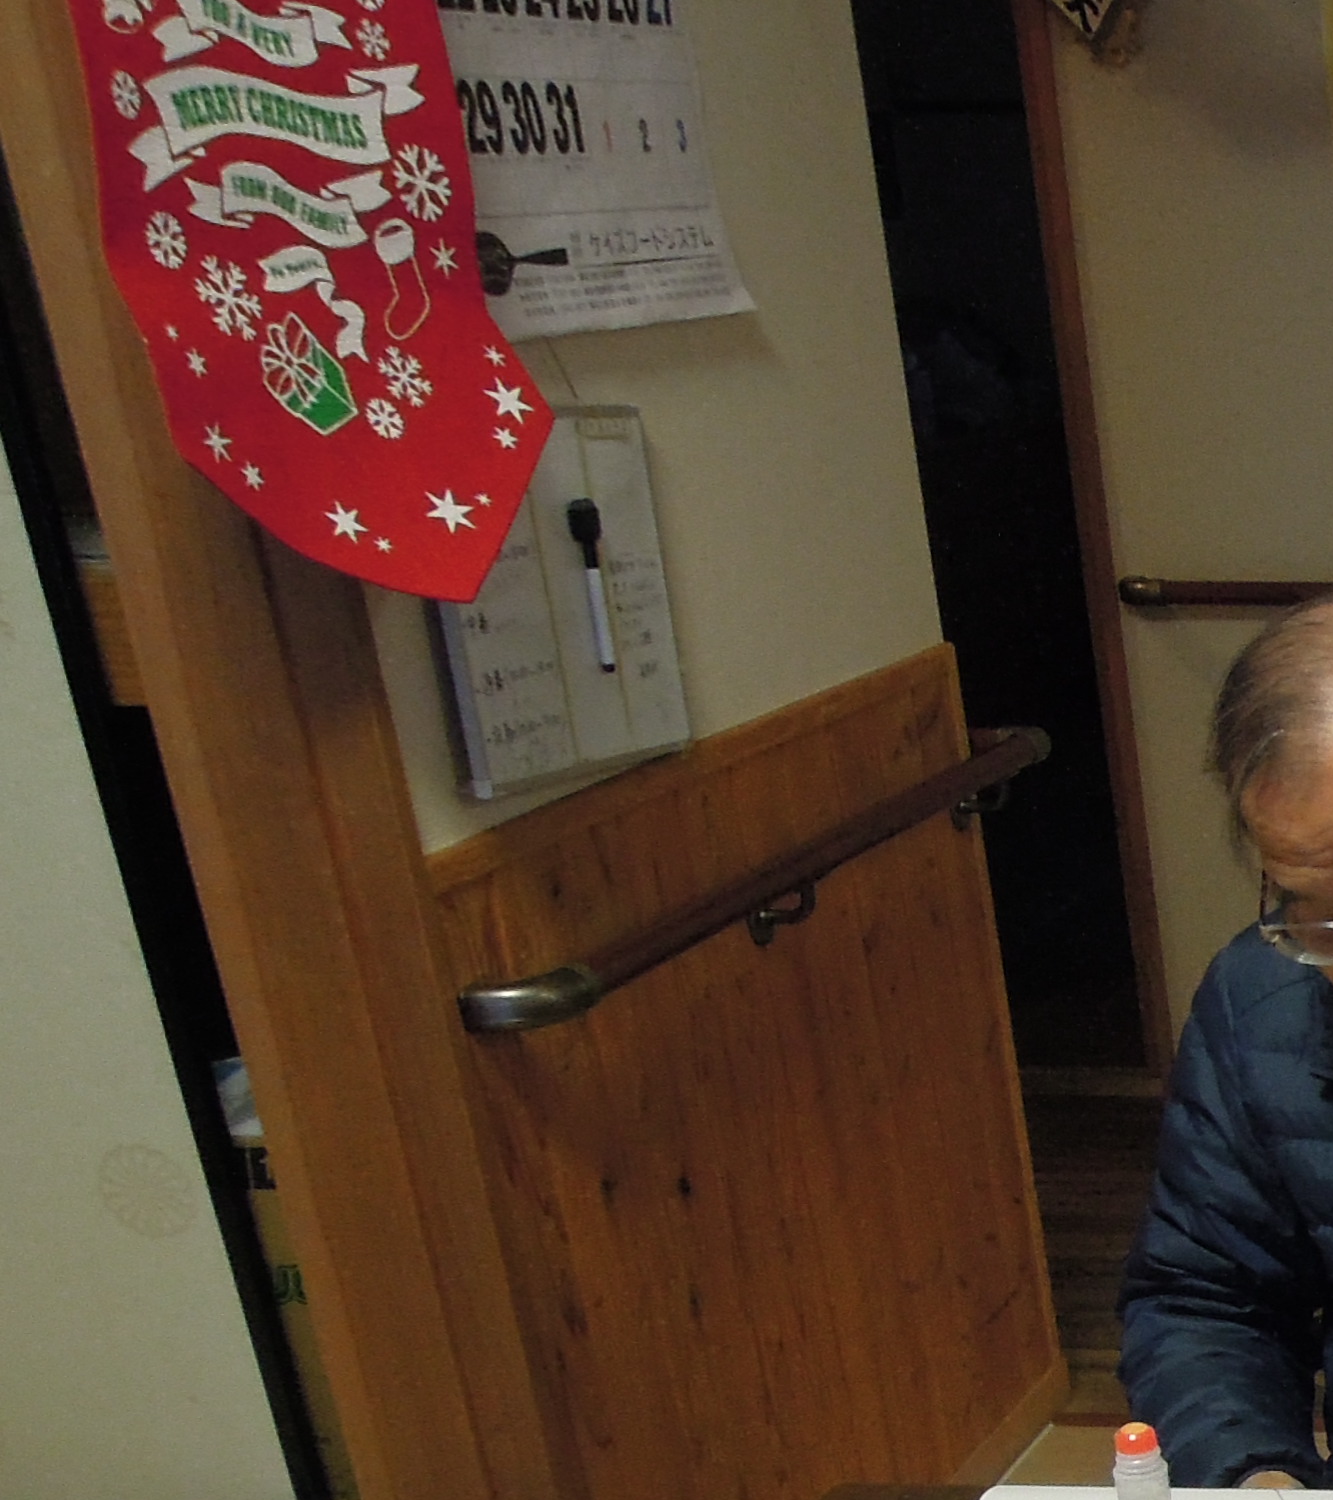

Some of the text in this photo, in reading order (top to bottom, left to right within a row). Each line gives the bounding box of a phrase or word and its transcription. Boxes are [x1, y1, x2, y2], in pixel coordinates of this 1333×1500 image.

[250, 21, 296, 58] VERY
[171, 84, 369, 149] MERRY CHRISTMAS
[457, 79, 504, 155] 29
[502, 81, 547, 155] 30
[546, 81, 586, 154] 31
[638, 118, 652, 152] 2
[302, 202, 349, 235] FAMILY
